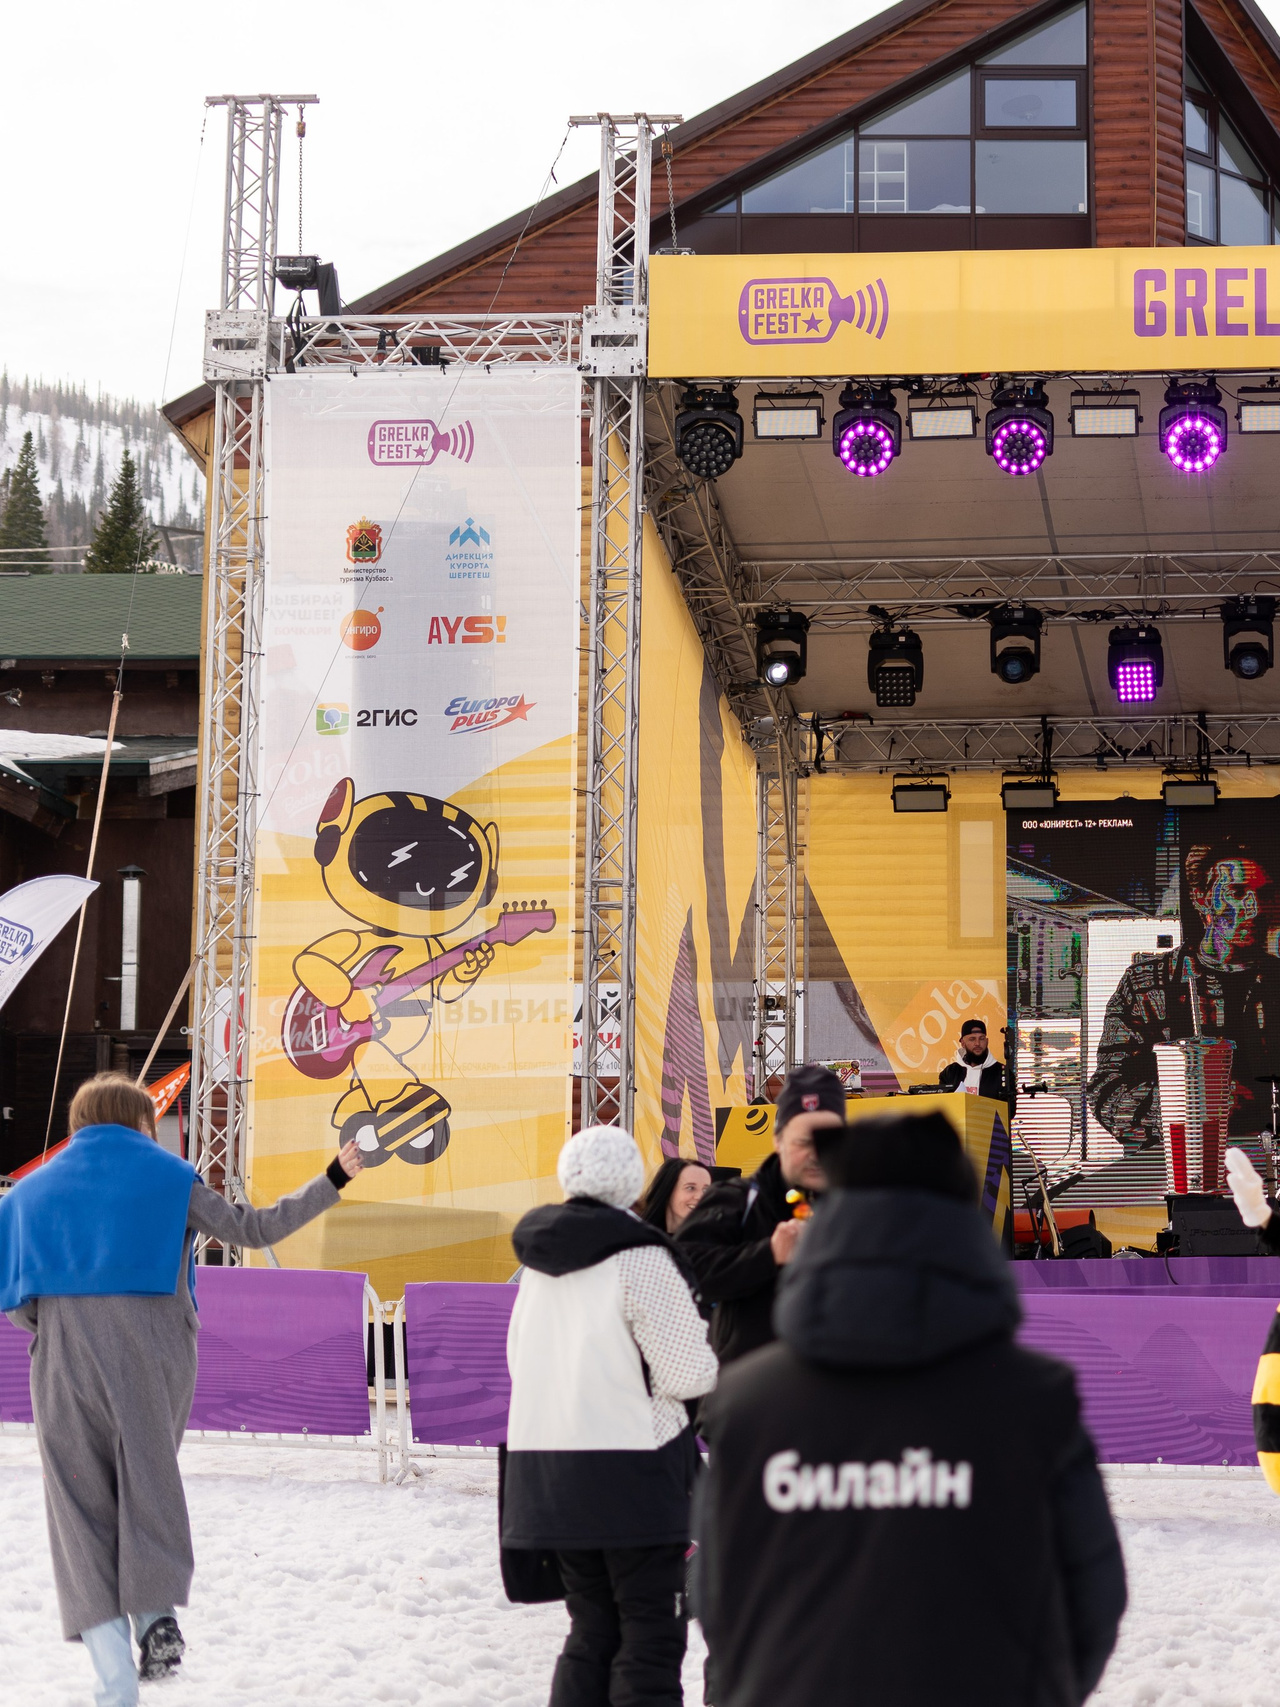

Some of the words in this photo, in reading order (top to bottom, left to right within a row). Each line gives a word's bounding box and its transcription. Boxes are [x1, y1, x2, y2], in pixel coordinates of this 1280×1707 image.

[754, 287, 824, 309] GRELKA
[754, 312, 801, 335] FEST
[378, 426, 430, 442] GRELKA
[378, 444, 412, 459] FEST
[445, 553, 494, 561] ДИРЕКЦИЯ
[343, 567, 386, 575] Министерство
[449, 571, 490, 579] ШЕРЕГЕШ
[428, 616, 507, 644] AYS!
[444, 695, 520, 716] Europa
[357, 708, 418, 727] 2ГИС
[1022, 820, 1038, 829] ООО
[1039, 819, 1084, 828] «ЮНИРЕСТ»
[1084, 819, 1097, 828] 12+
[1098, 818, 1133, 827] РЕКЛАМА
[895, 979, 979, 1069] Cola
[762, 1446, 975, 1513] билайн
